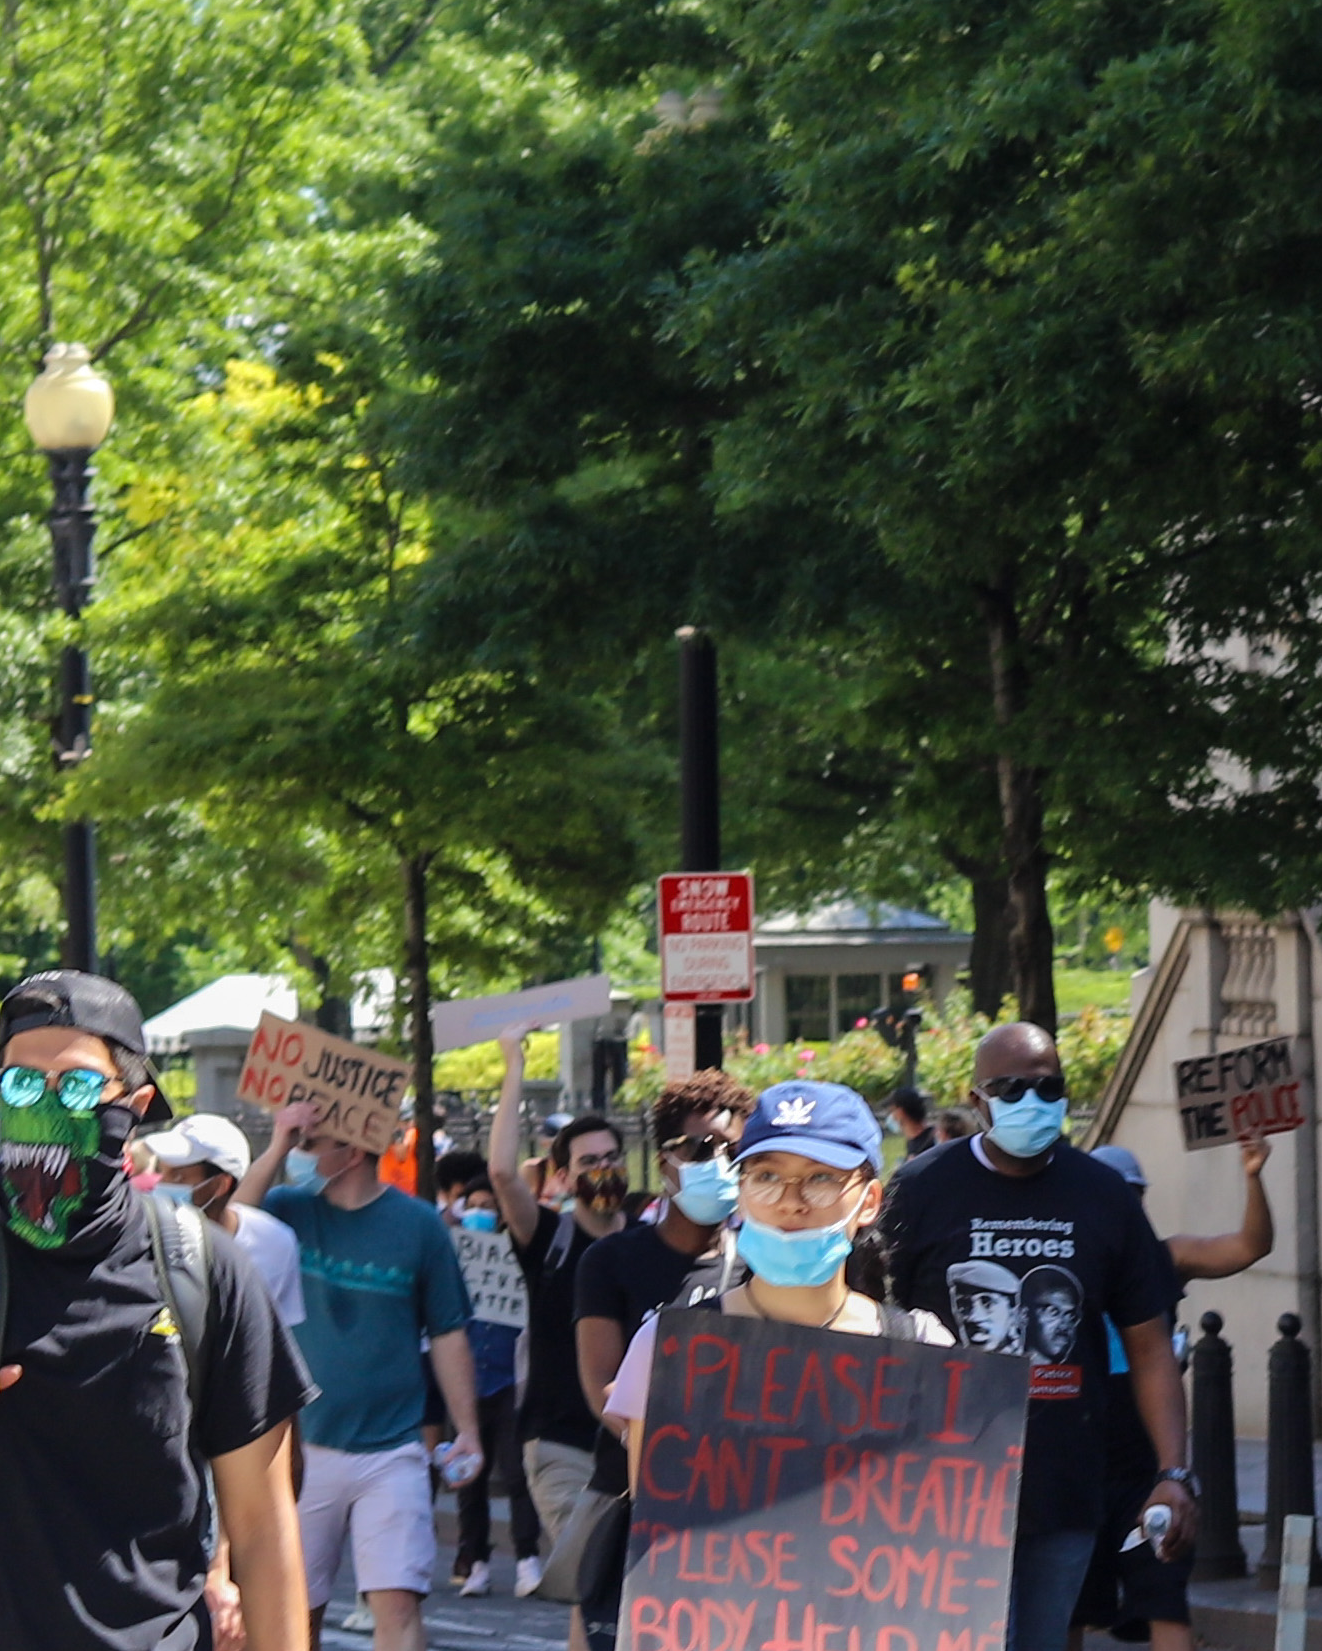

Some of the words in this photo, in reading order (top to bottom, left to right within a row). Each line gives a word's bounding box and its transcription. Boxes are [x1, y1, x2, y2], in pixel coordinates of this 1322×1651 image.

[677, 879, 730, 898] SNOW
[680, 911, 731, 933] ROUTE
[241, 1066, 286, 1106] NO
[251, 1026, 306, 1068] NO
[303, 1048, 406, 1108] JUSTICE
[1178, 1042, 1293, 1099] REFORM
[1180, 1101, 1229, 1143] THE
[969, 1231, 1076, 1259] Heroes
[970, 1217, 1075, 1236] Remembering
[458, 1233, 517, 1266] BLAC
[927, 1360, 974, 1445] I
[642, 1424, 811, 1511] CANT
[825, 1534, 1000, 1615] SOME-
